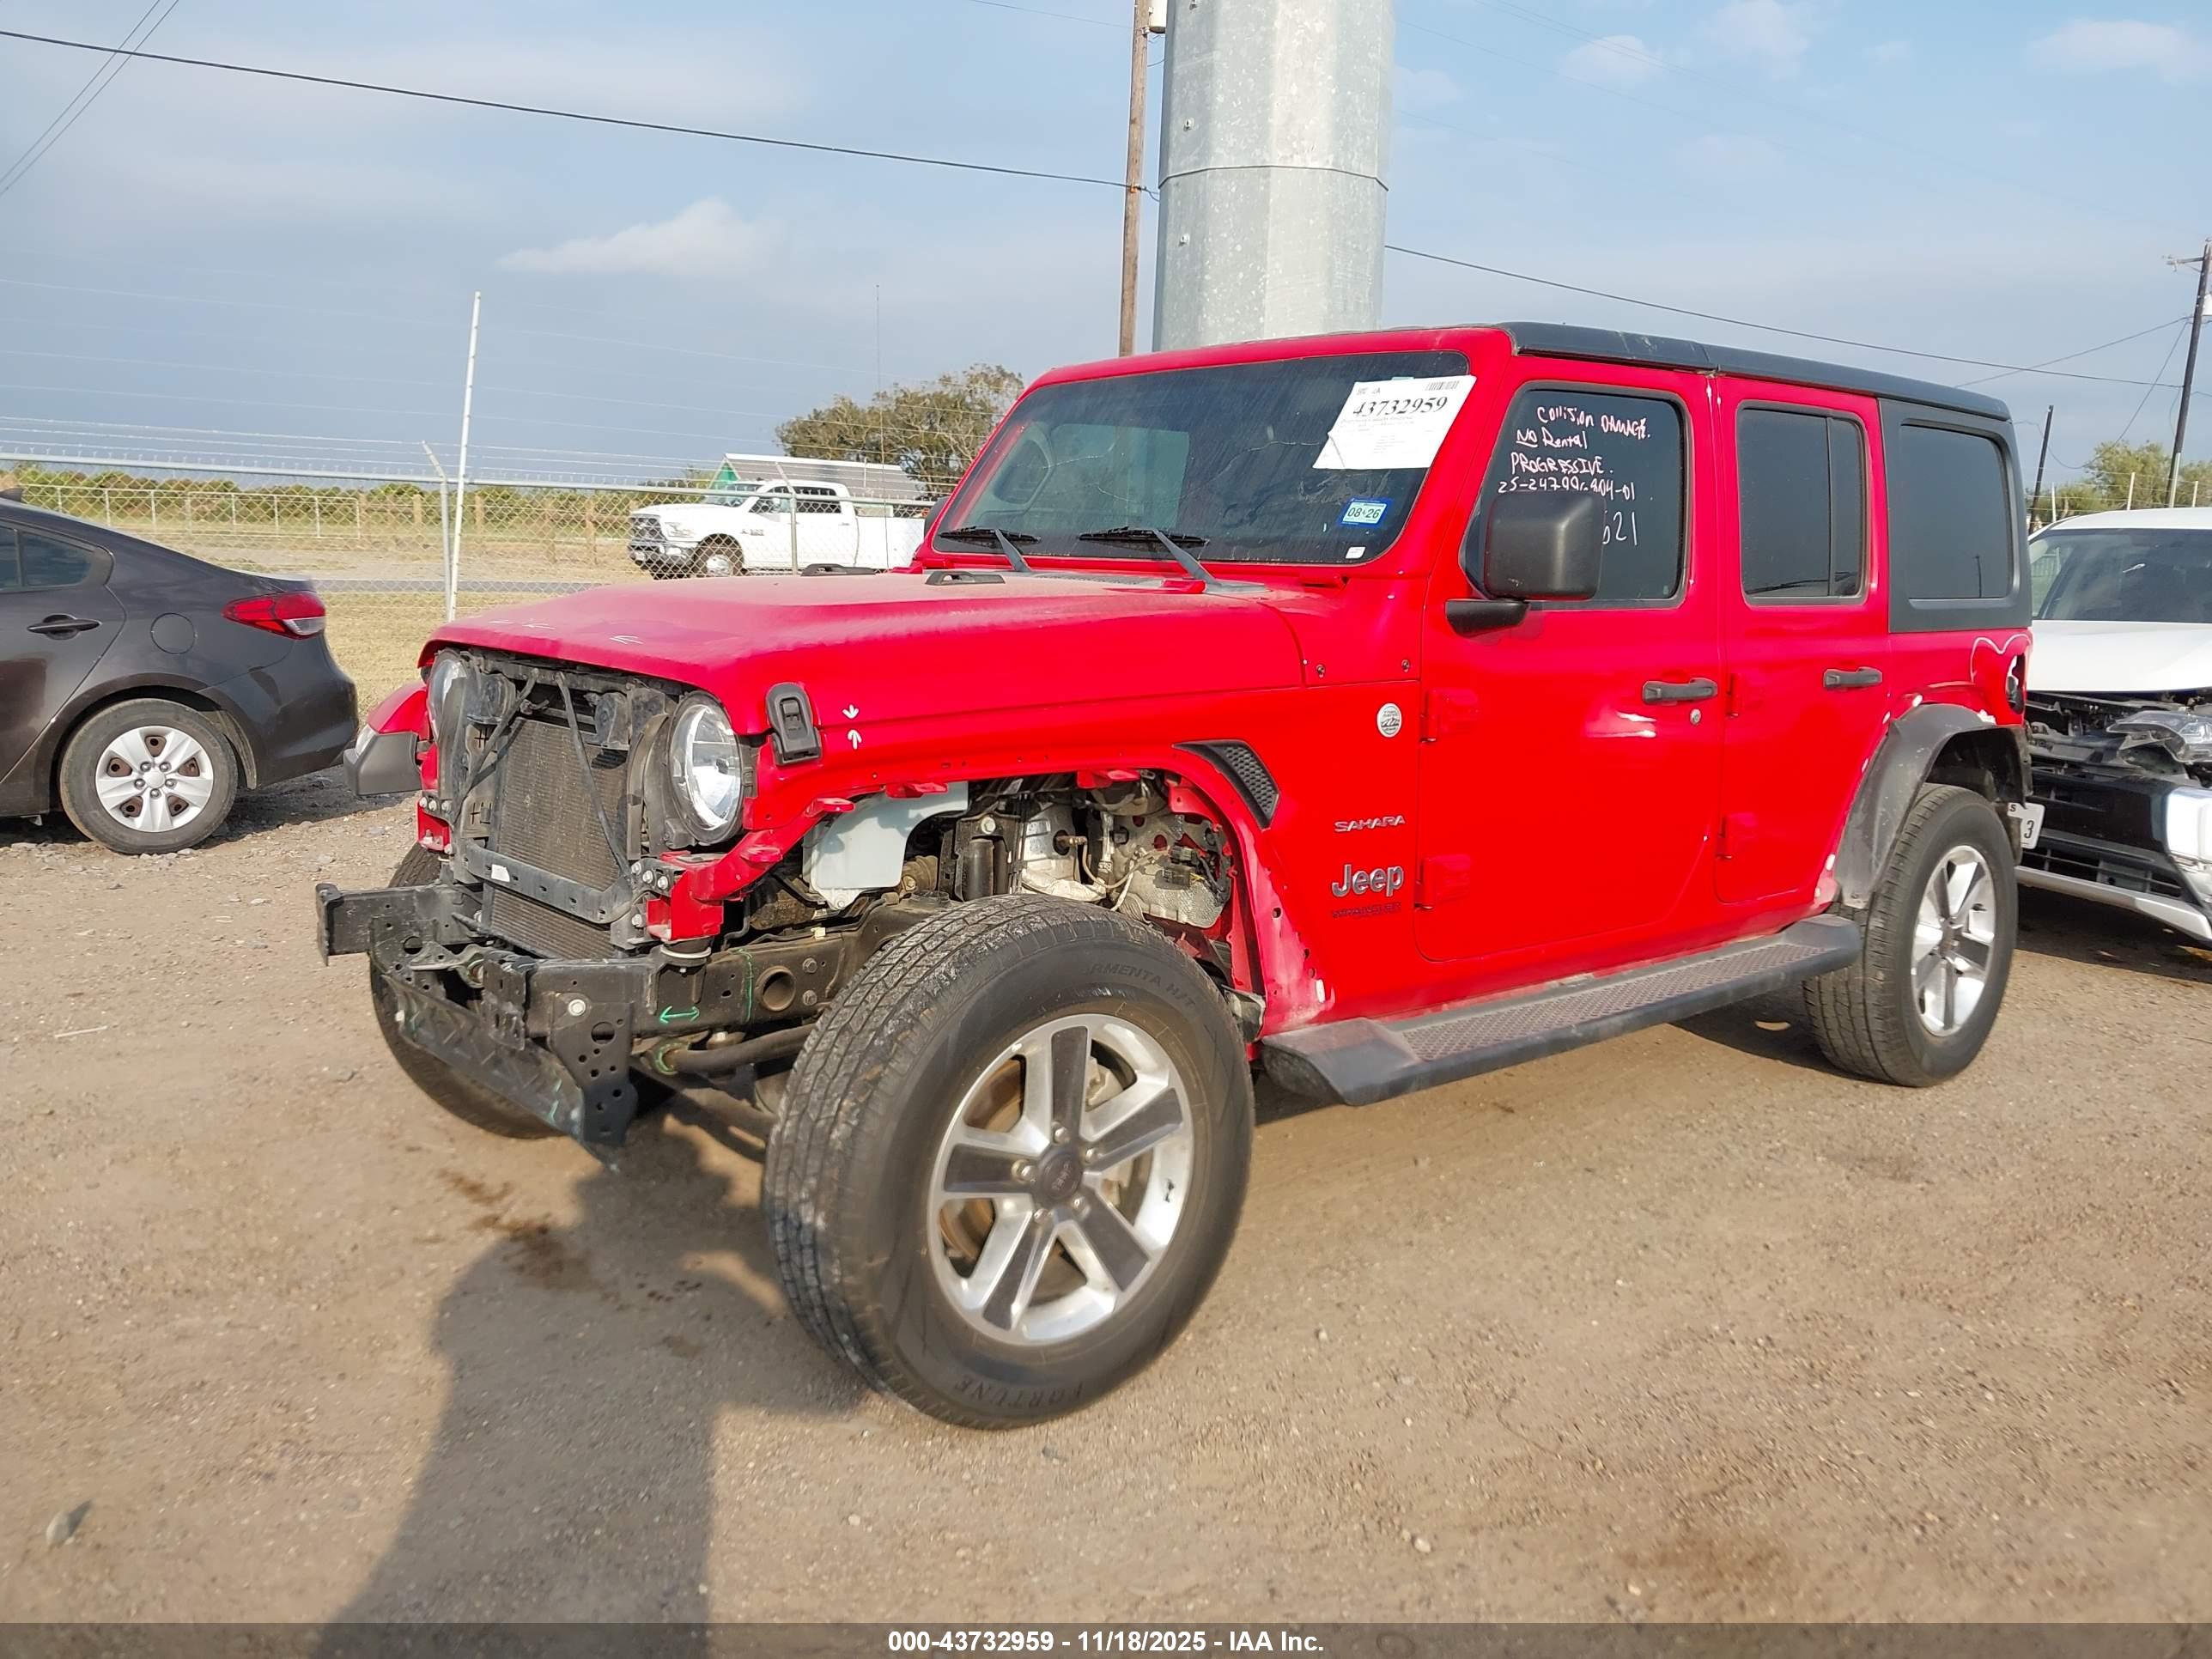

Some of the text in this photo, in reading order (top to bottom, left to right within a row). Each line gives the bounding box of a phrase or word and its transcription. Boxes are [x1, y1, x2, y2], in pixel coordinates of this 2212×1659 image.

[1353, 397, 1448, 416] 43732959
[1541, 427, 1588, 449] Rental
[1334, 815, 1406, 832] SAHARA
[1331, 864, 1404, 897] Jeep
